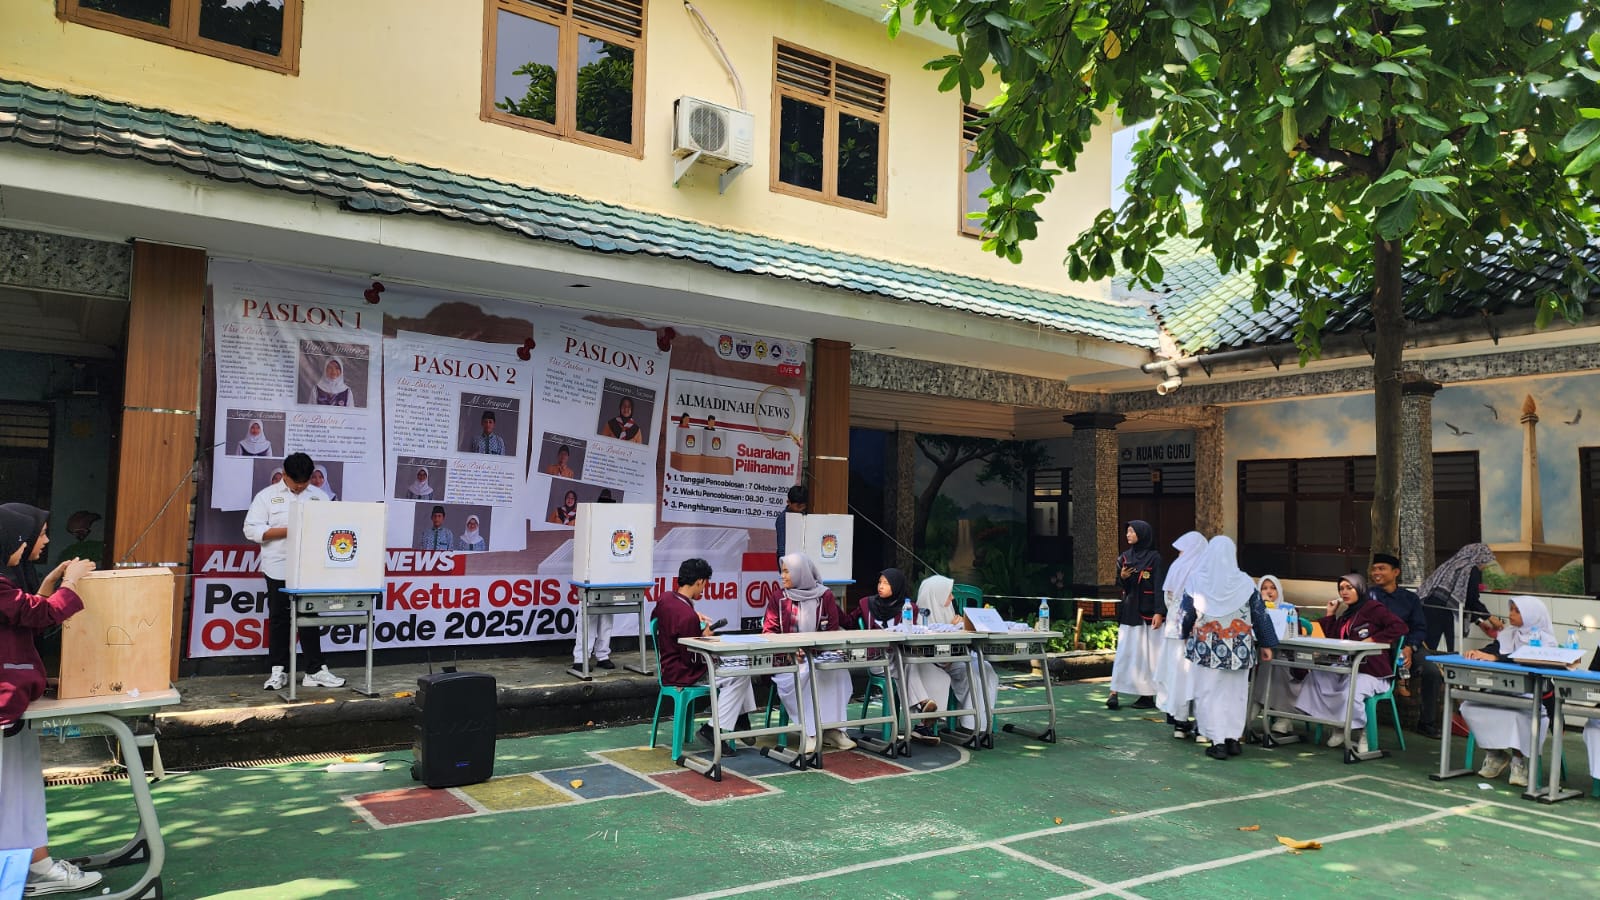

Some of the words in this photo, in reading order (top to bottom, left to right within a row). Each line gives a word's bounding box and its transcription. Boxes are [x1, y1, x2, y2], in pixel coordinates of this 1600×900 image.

[242, 298, 346, 328] PASLON
[355, 312, 362, 330] 1
[565, 336, 642, 372] PASLON
[645, 360, 655, 376] 3
[412, 354, 500, 382] PASLON
[505, 367, 517, 385] 2
[779, 365, 793, 374] LIVE
[676, 393, 755, 414] ALMADINAH
[758, 404, 790, 420] NEWS
[737, 443, 791, 462] Suarakan
[1136, 446, 1163, 461] RUANG
[1167, 444, 1190, 459] GURU
[735, 458, 794, 476] Pilihanmu!
[679, 474, 705, 485] Tanggal
[705, 478, 744, 490] Pencoblosan
[753, 482, 777, 493] Oktober
[777, 486, 790, 494] 202
[672, 487, 679, 495] 2.
[680, 487, 702, 497] Waktu
[702, 490, 742, 501] Pencoblosan
[769, 497, 783, 505] 12.00
[670, 501, 677, 509] 3.
[678, 501, 721, 513] Penghitungan
[722, 506, 741, 515] Suara
[745, 507, 762, 516] 13.20
[386, 551, 455, 572] NEWS
[356, 600, 364, 608] 2
[386, 581, 480, 611] Ketua
[487, 578, 561, 608] OSIS
[202, 618, 270, 651] OSI
[444, 607, 577, 640] 2025/20
[1446, 669, 1456, 680] D
[1502, 679, 1515, 688] 11
